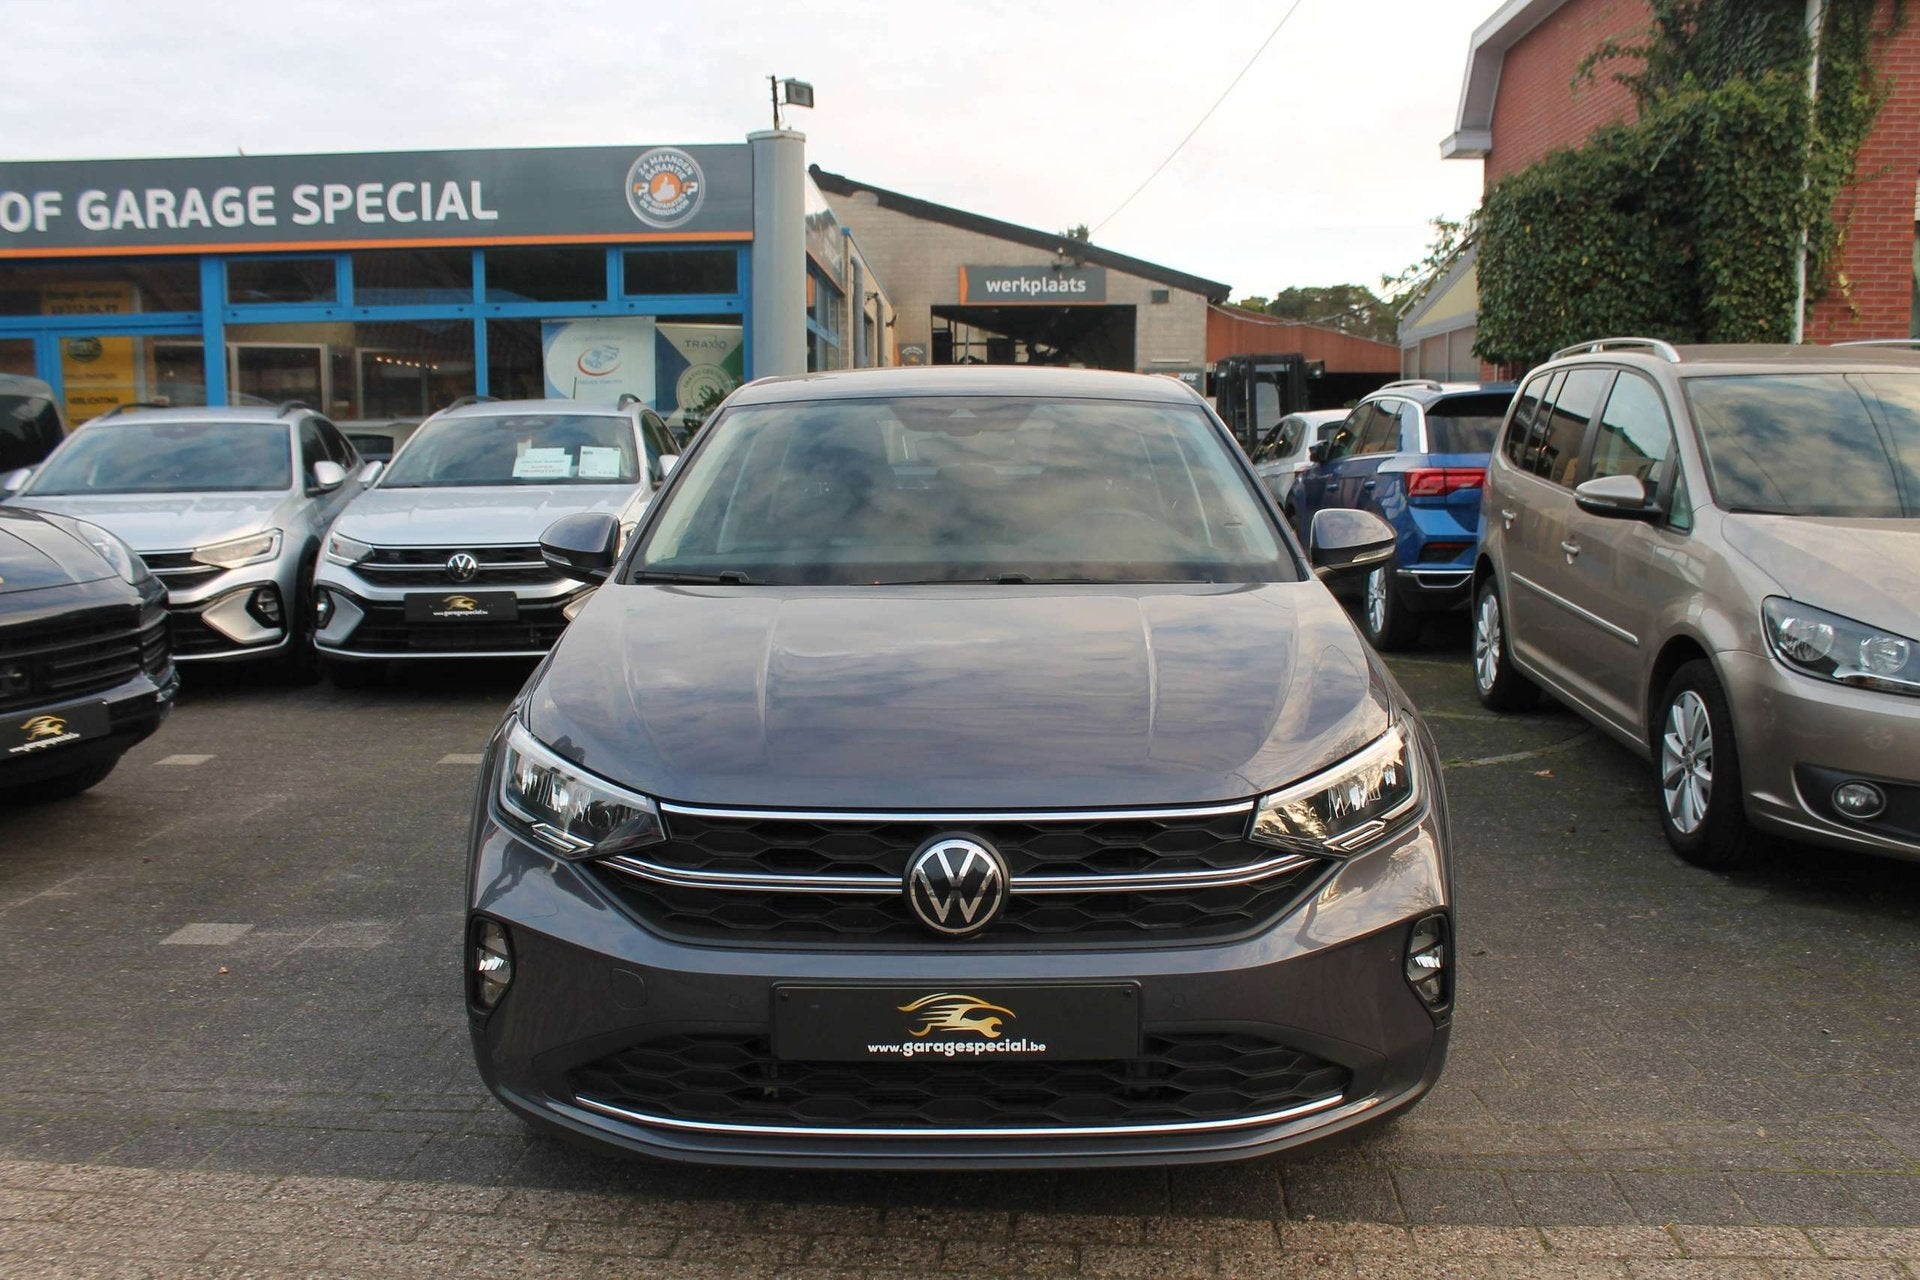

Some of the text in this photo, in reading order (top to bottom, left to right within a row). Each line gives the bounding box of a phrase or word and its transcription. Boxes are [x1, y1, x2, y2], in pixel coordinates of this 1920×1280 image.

[649, 154, 694, 175] MAANDEN
[0, 181, 499, 232] OF GARAGE SPECIAL
[986, 276, 1087, 296] werkplaats
[685, 336, 727, 350] TRAXIO
[910, 839, 1003, 933] VW
[867, 1038, 1047, 1058] www.garagespecial.be
